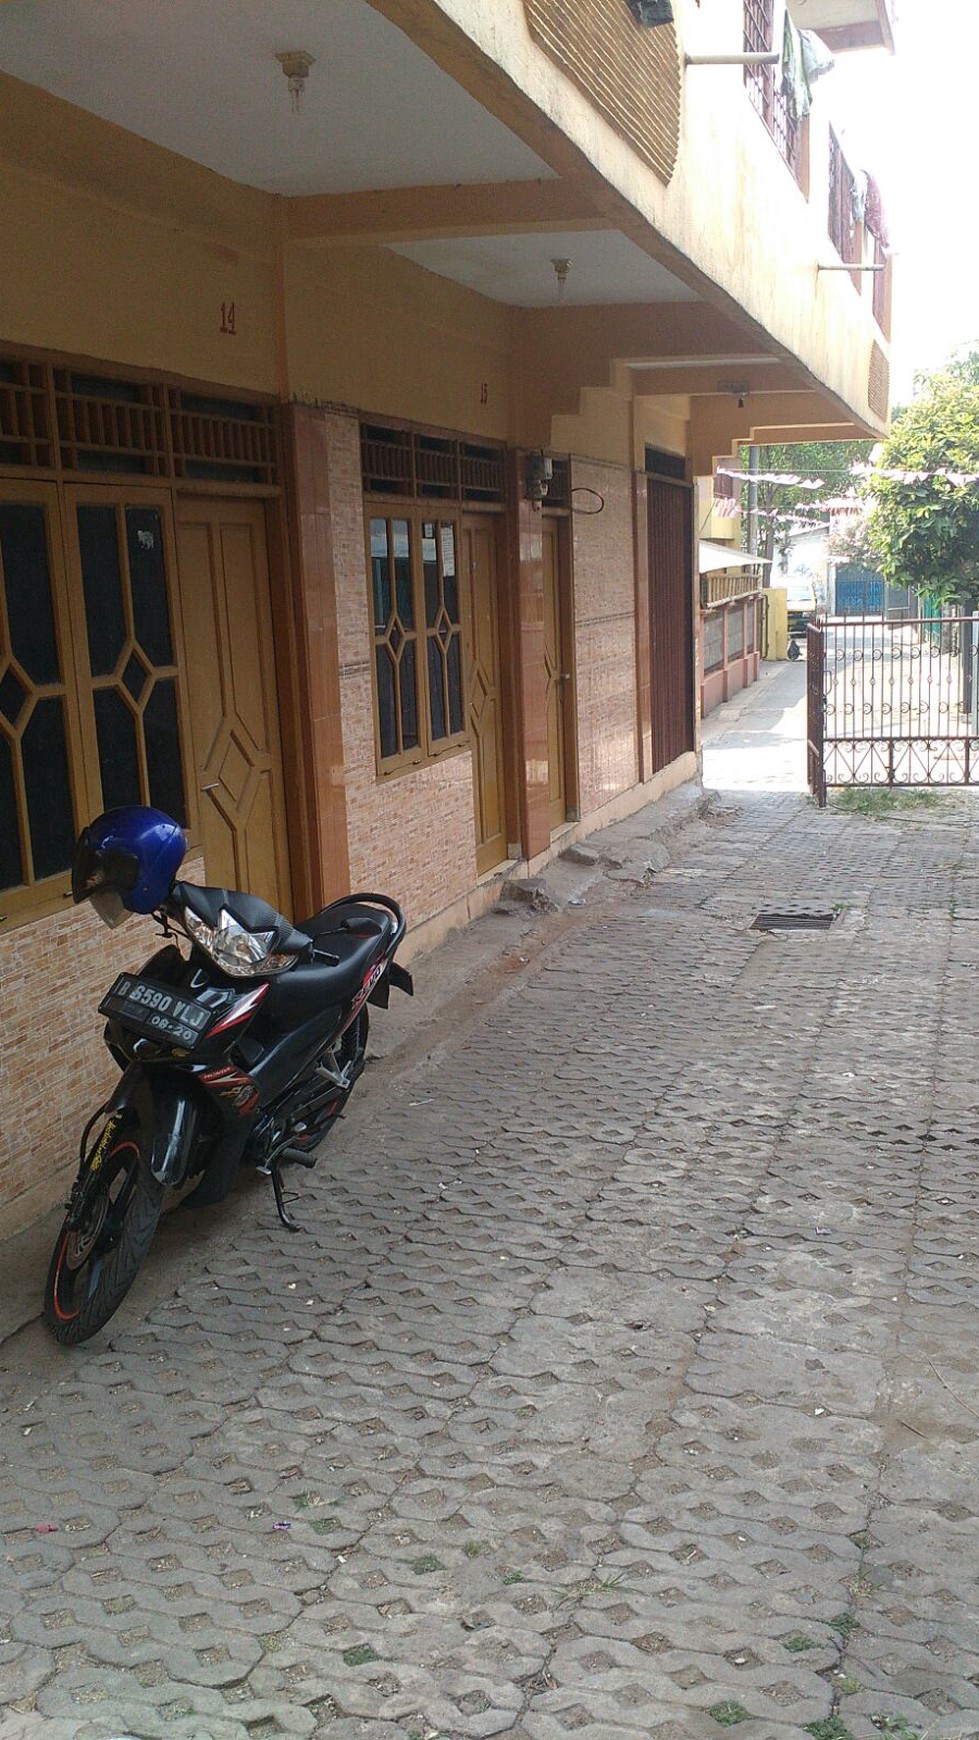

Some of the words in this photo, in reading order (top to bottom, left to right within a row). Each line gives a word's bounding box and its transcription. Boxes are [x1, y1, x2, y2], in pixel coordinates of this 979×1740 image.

[220, 301, 237, 335] 14
[118, 981, 131, 996] B
[173, 1001, 205, 1027] VLJ
